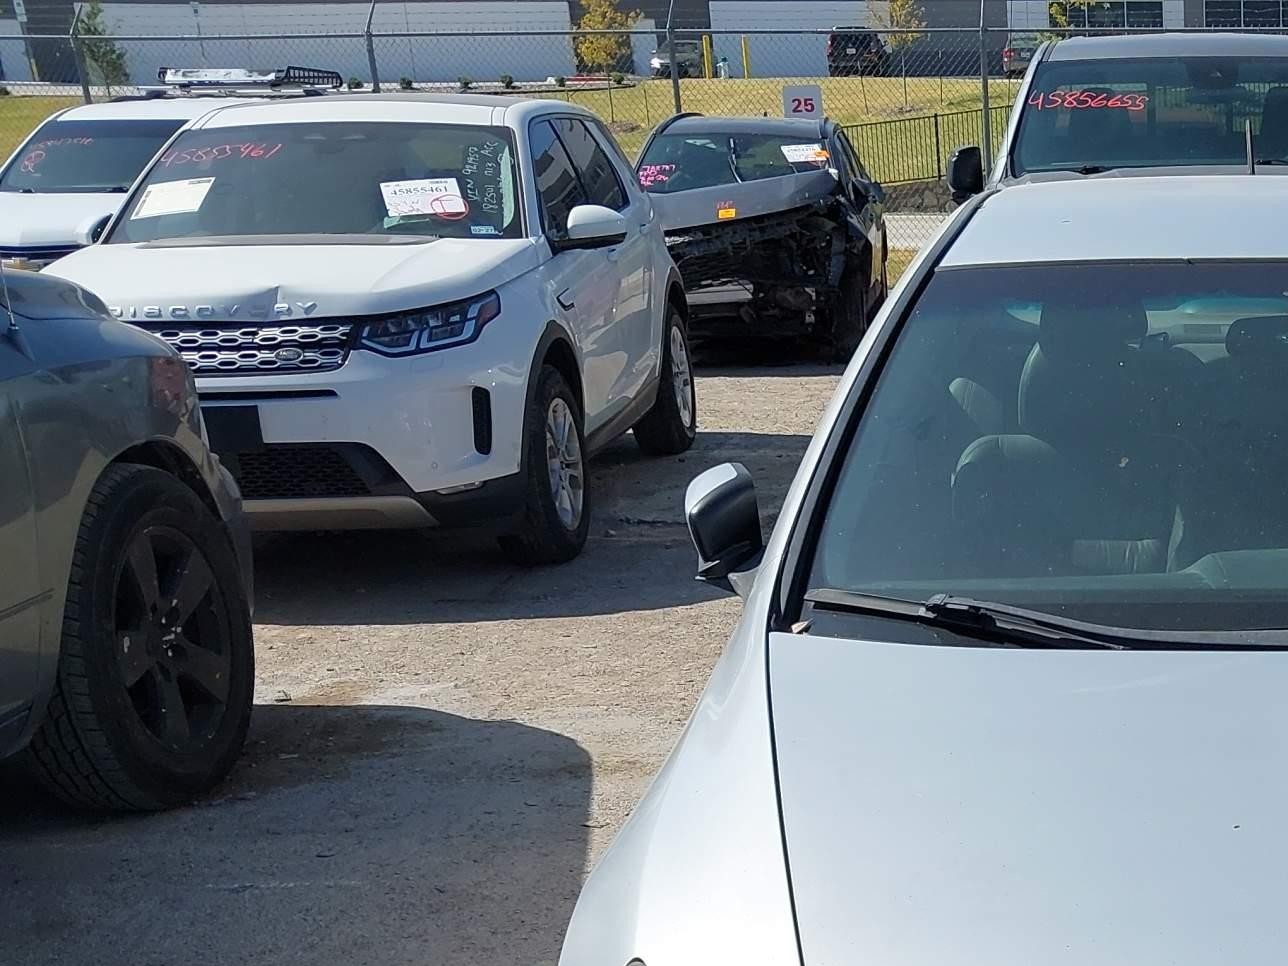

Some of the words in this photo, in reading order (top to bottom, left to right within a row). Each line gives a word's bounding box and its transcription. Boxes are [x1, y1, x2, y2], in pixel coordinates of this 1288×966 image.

[791, 98, 815, 114] 25
[1028, 89, 1149, 111] 45856655
[160, 142, 282, 169] 45855461
